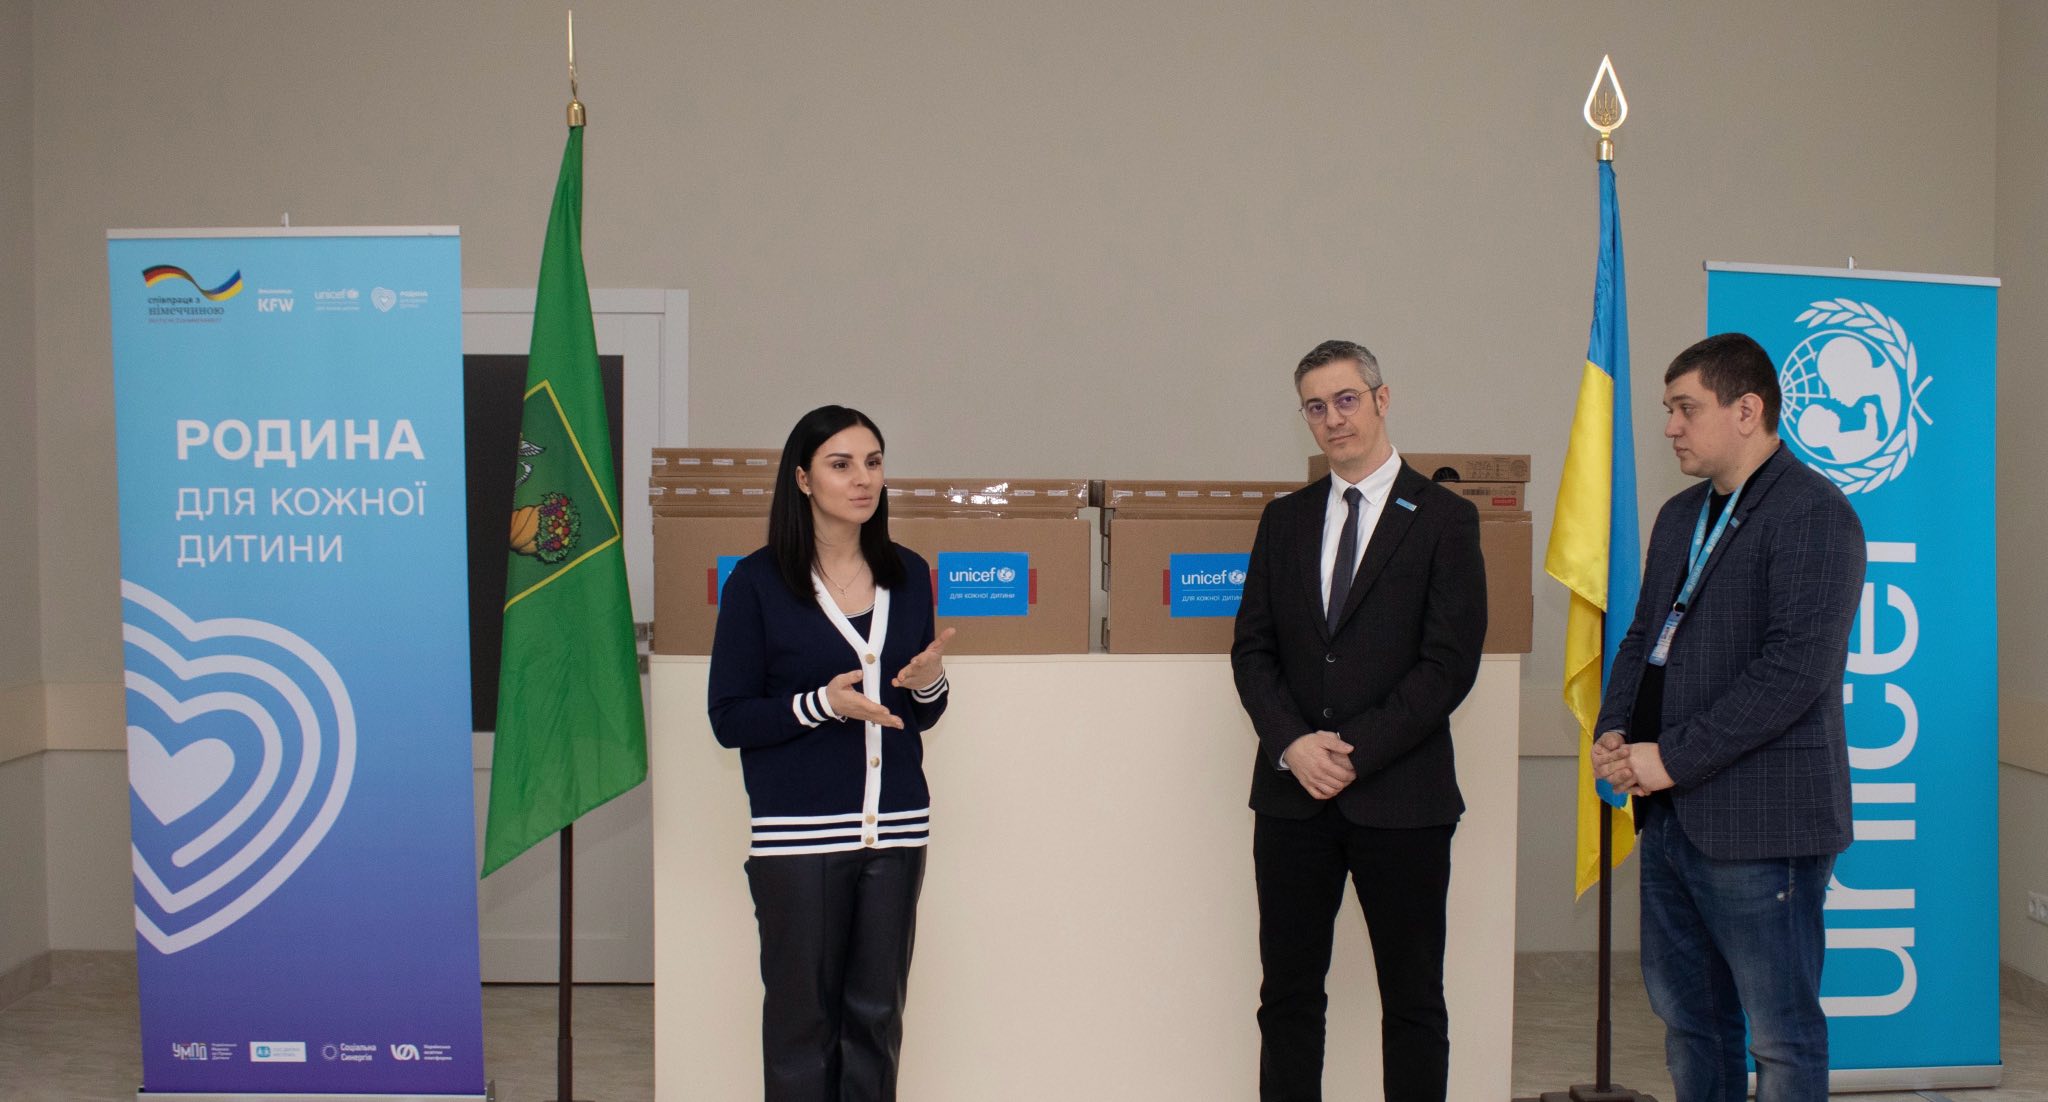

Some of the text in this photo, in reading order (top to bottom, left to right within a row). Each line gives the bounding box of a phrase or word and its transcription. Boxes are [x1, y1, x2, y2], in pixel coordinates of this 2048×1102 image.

[314, 288, 346, 300] unicef
[258, 298, 294, 312] KFW
[176, 419, 425, 468] РОДИНА
[175, 481, 427, 521] ДЛЯ КОЖНОЇ
[177, 535, 343, 568] ДИТИНИ
[949, 567, 996, 582] unicef
[1181, 570, 1228, 585] unicef
